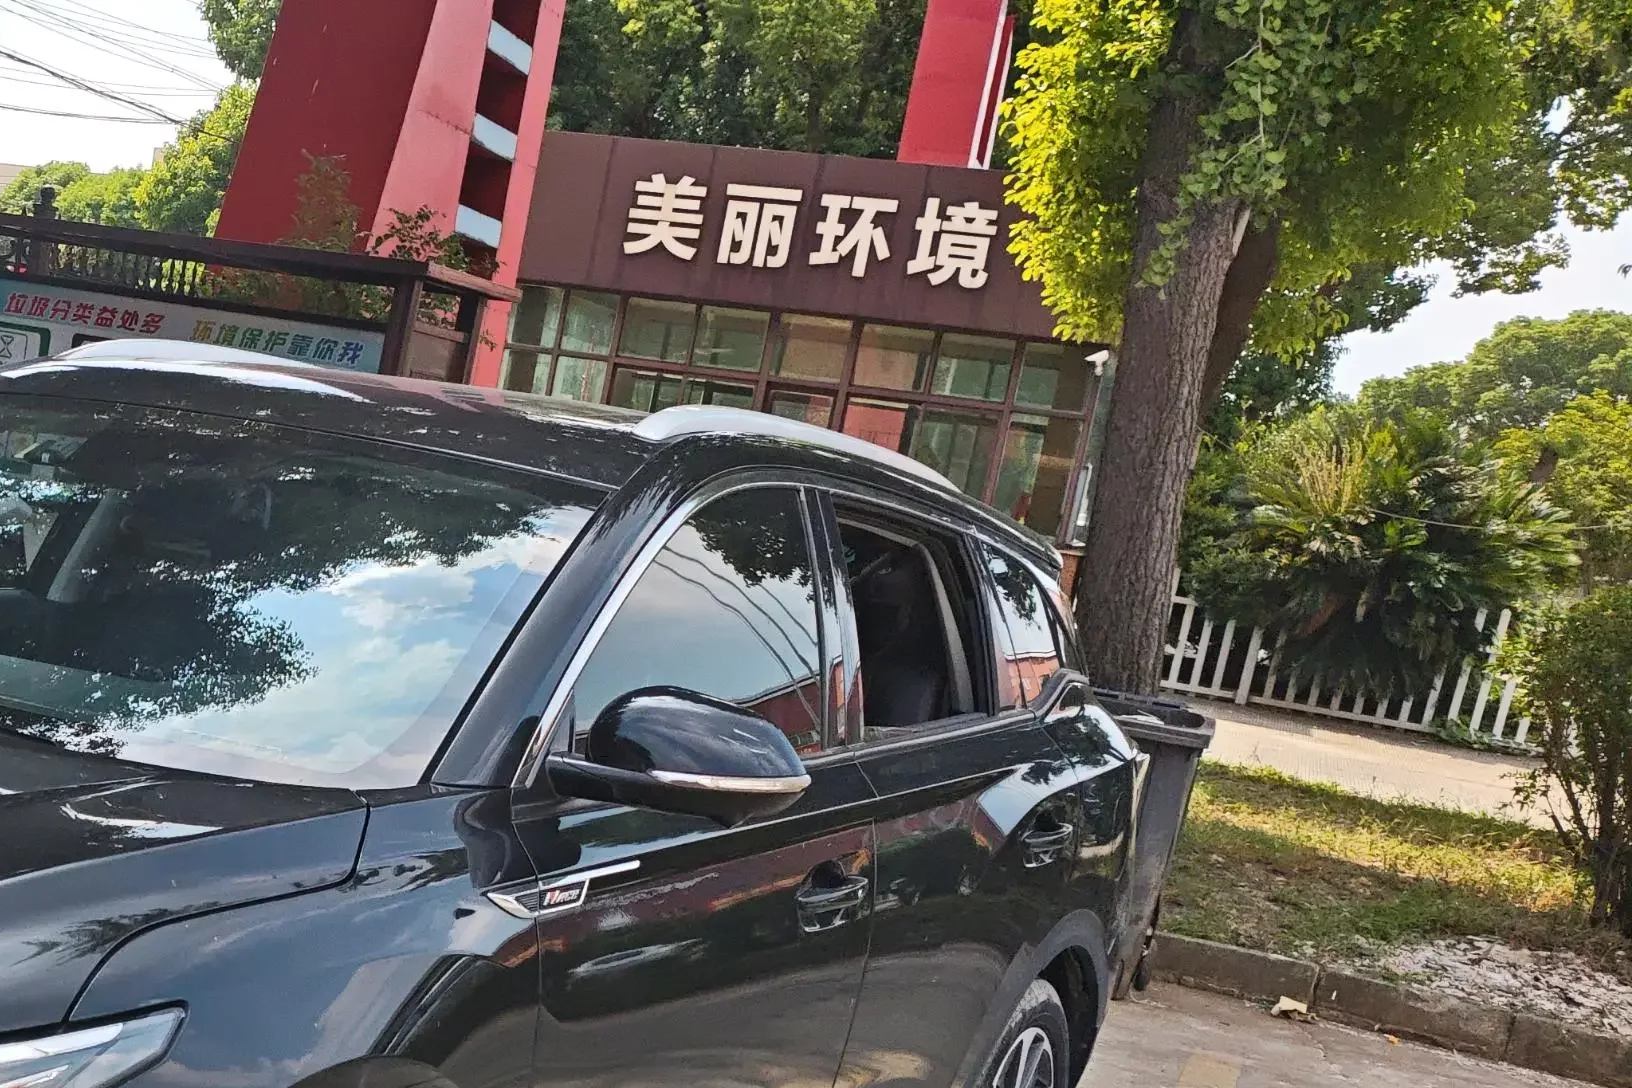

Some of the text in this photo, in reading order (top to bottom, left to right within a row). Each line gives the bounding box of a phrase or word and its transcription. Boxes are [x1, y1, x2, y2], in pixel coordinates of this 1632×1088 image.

[623, 172, 998, 289] 美丽环境
[3, 292, 364, 365] 垃圾分类益处多 环境保护靠你我
